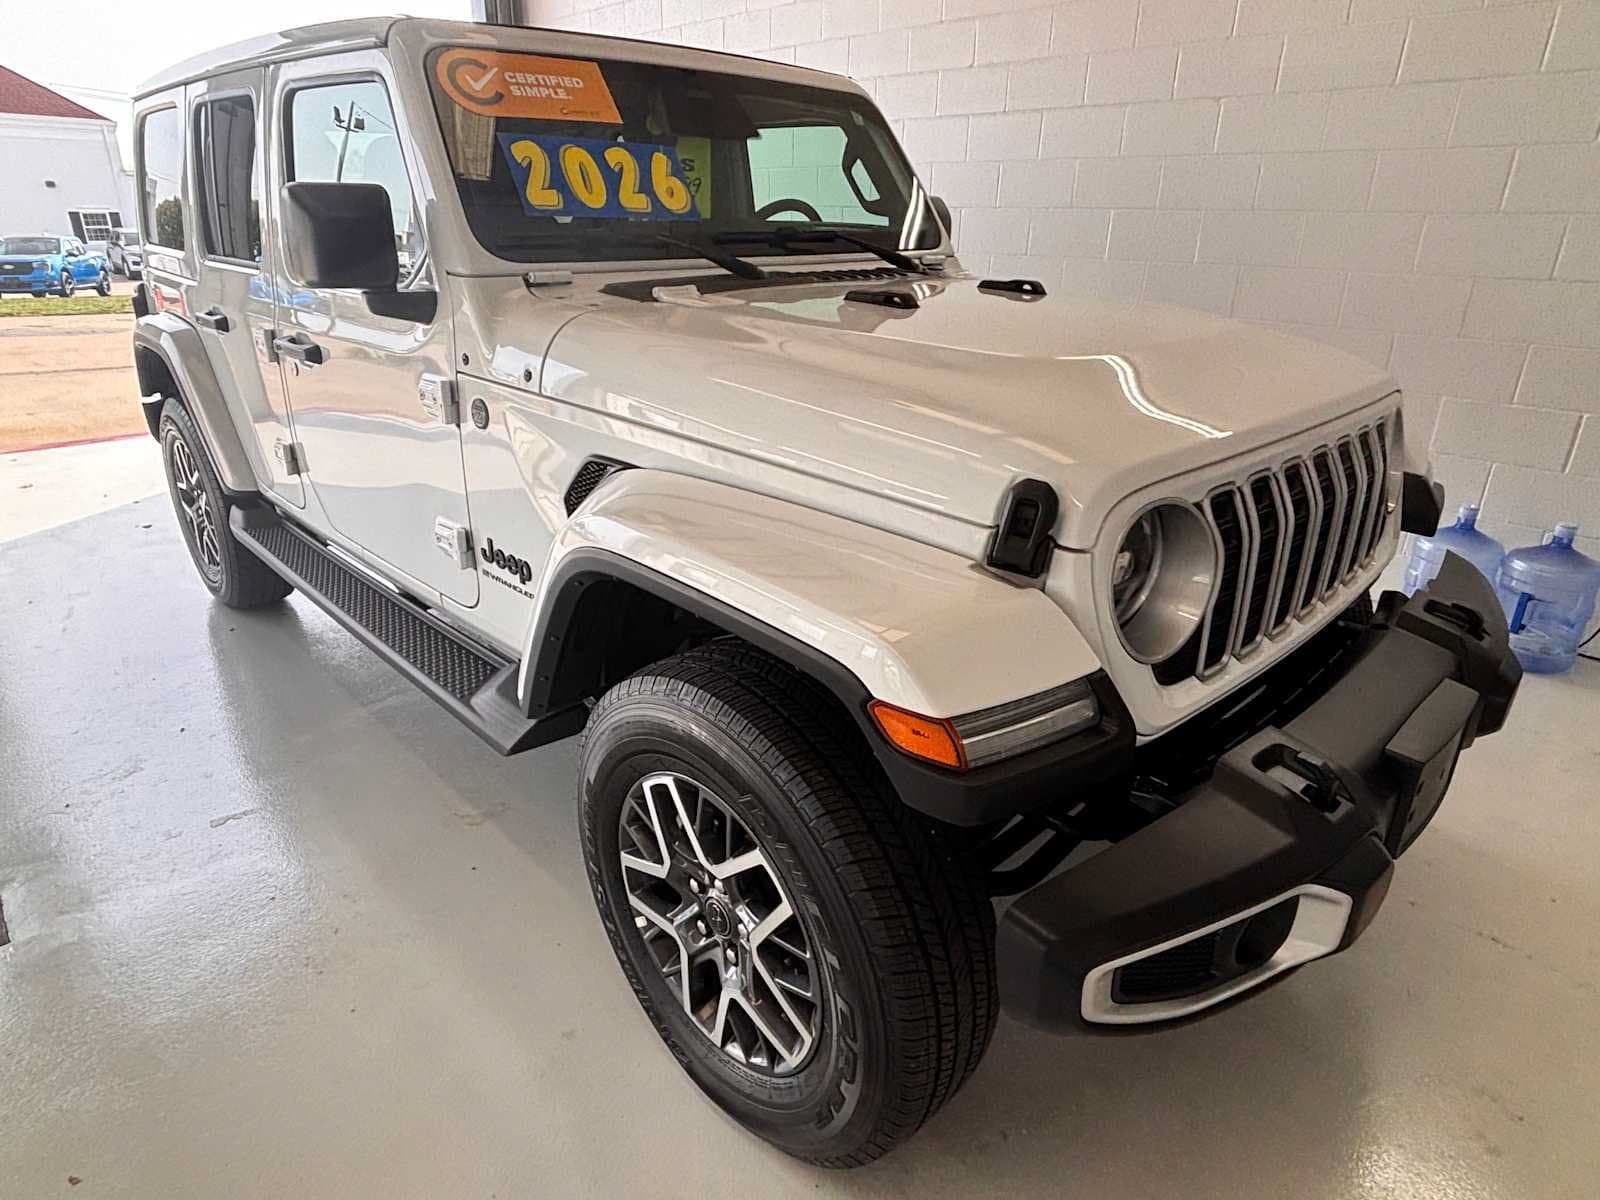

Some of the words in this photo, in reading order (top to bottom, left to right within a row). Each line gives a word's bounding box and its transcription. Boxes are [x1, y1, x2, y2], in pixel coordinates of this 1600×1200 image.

[503, 71, 584, 88] CERTIFIED
[511, 140, 691, 214] 2026
[481, 537, 532, 585] Jeep
